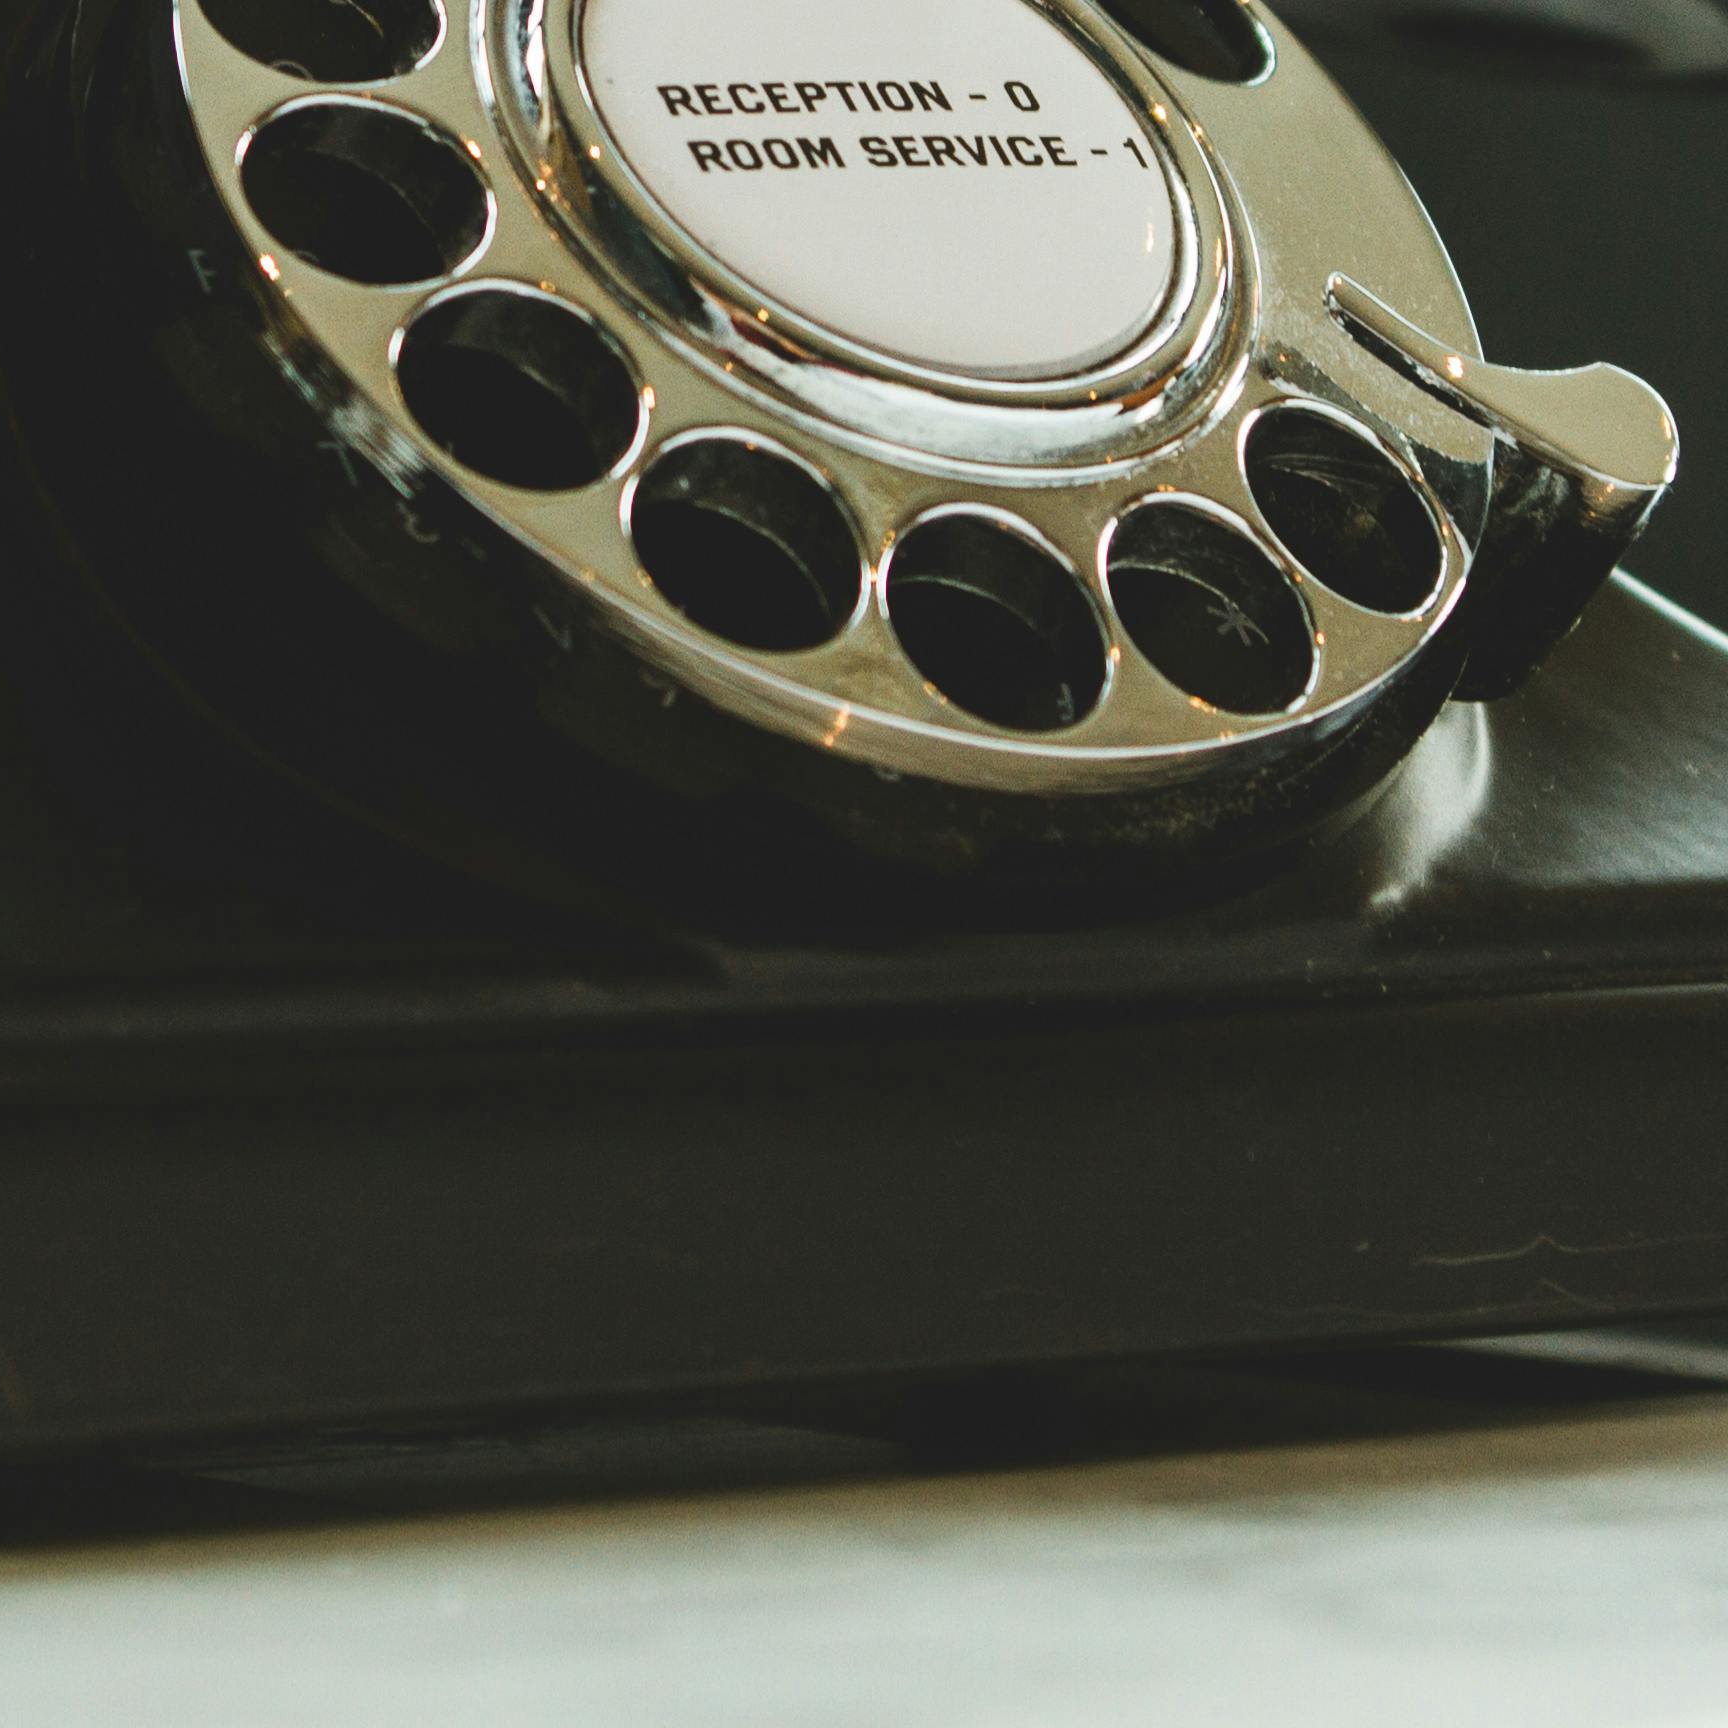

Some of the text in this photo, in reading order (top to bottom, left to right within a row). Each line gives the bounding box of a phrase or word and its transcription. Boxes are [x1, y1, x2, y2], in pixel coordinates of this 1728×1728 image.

[656, 81, 953, 116] RECEPTION
[687, 137, 846, 173] ROOM
[858, 135, 1078, 168] SERVICE
[1123, 137, 1150, 169] 1
